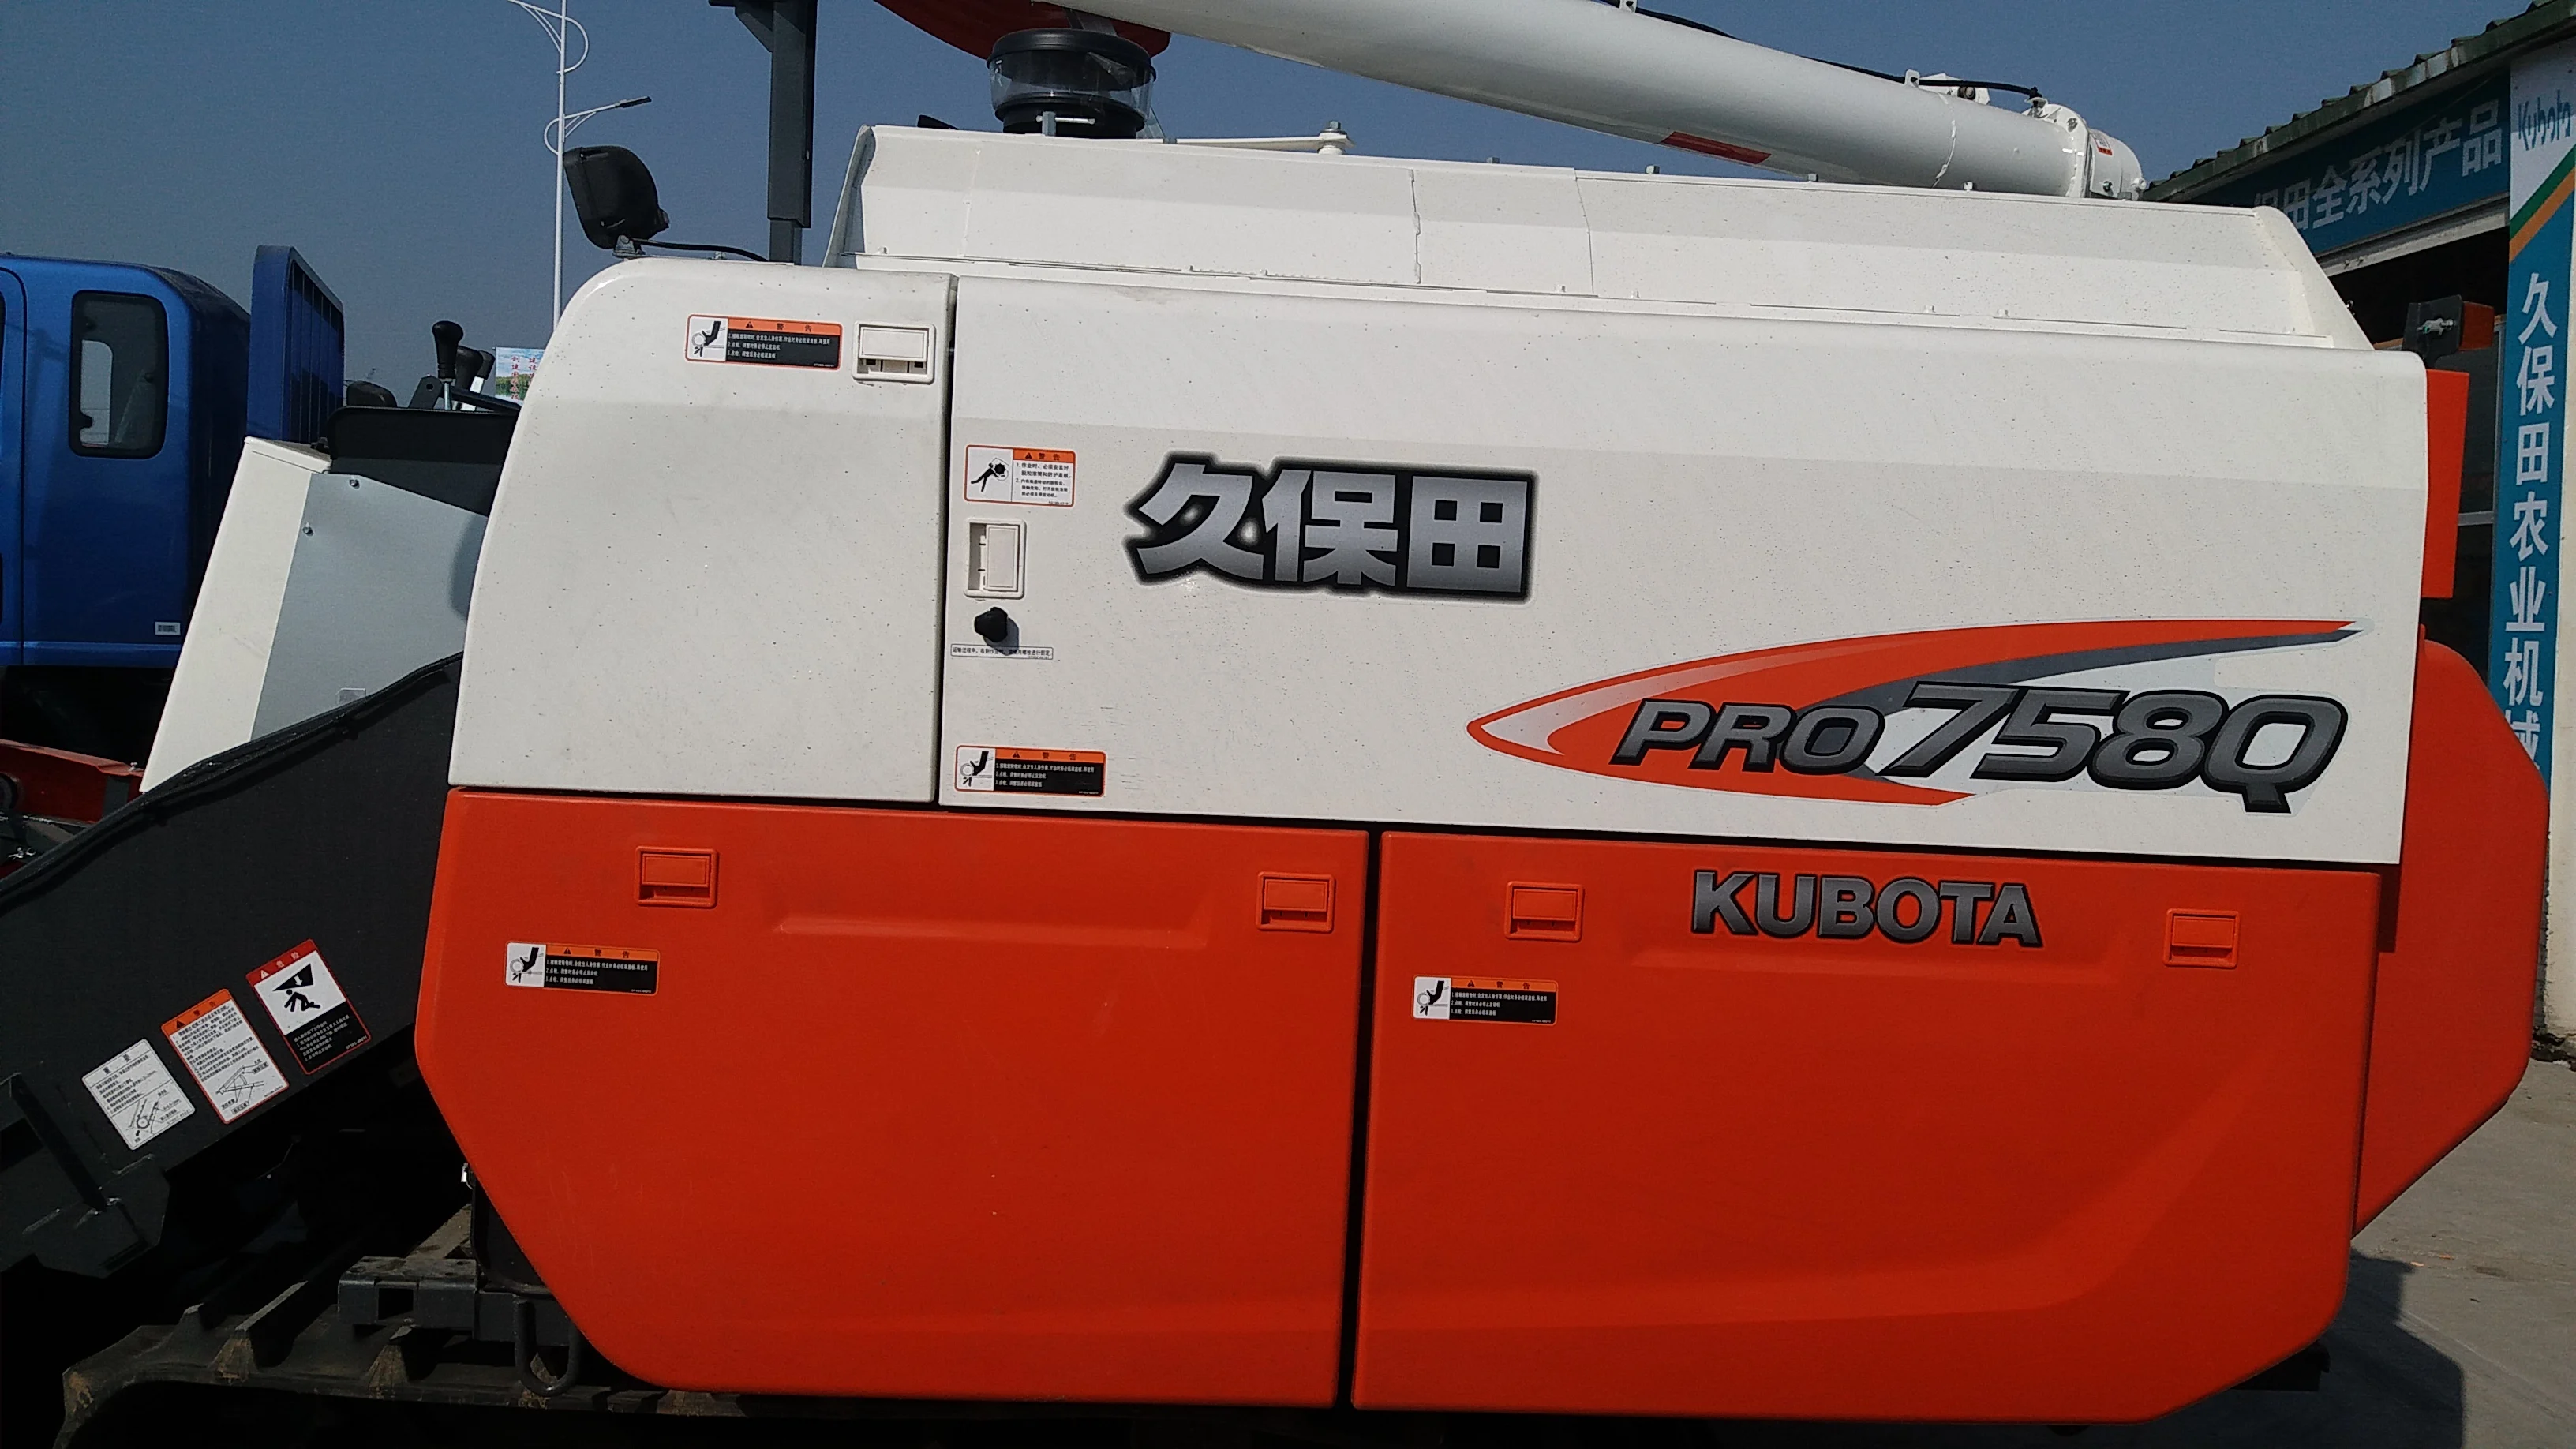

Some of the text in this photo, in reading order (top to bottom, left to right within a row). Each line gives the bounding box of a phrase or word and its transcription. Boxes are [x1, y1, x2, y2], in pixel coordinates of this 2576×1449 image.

[2518, 89, 2571, 151] Kubota
[1130, 455, 1534, 601] 久保田
[1691, 869, 2042, 948] KUBOTA
